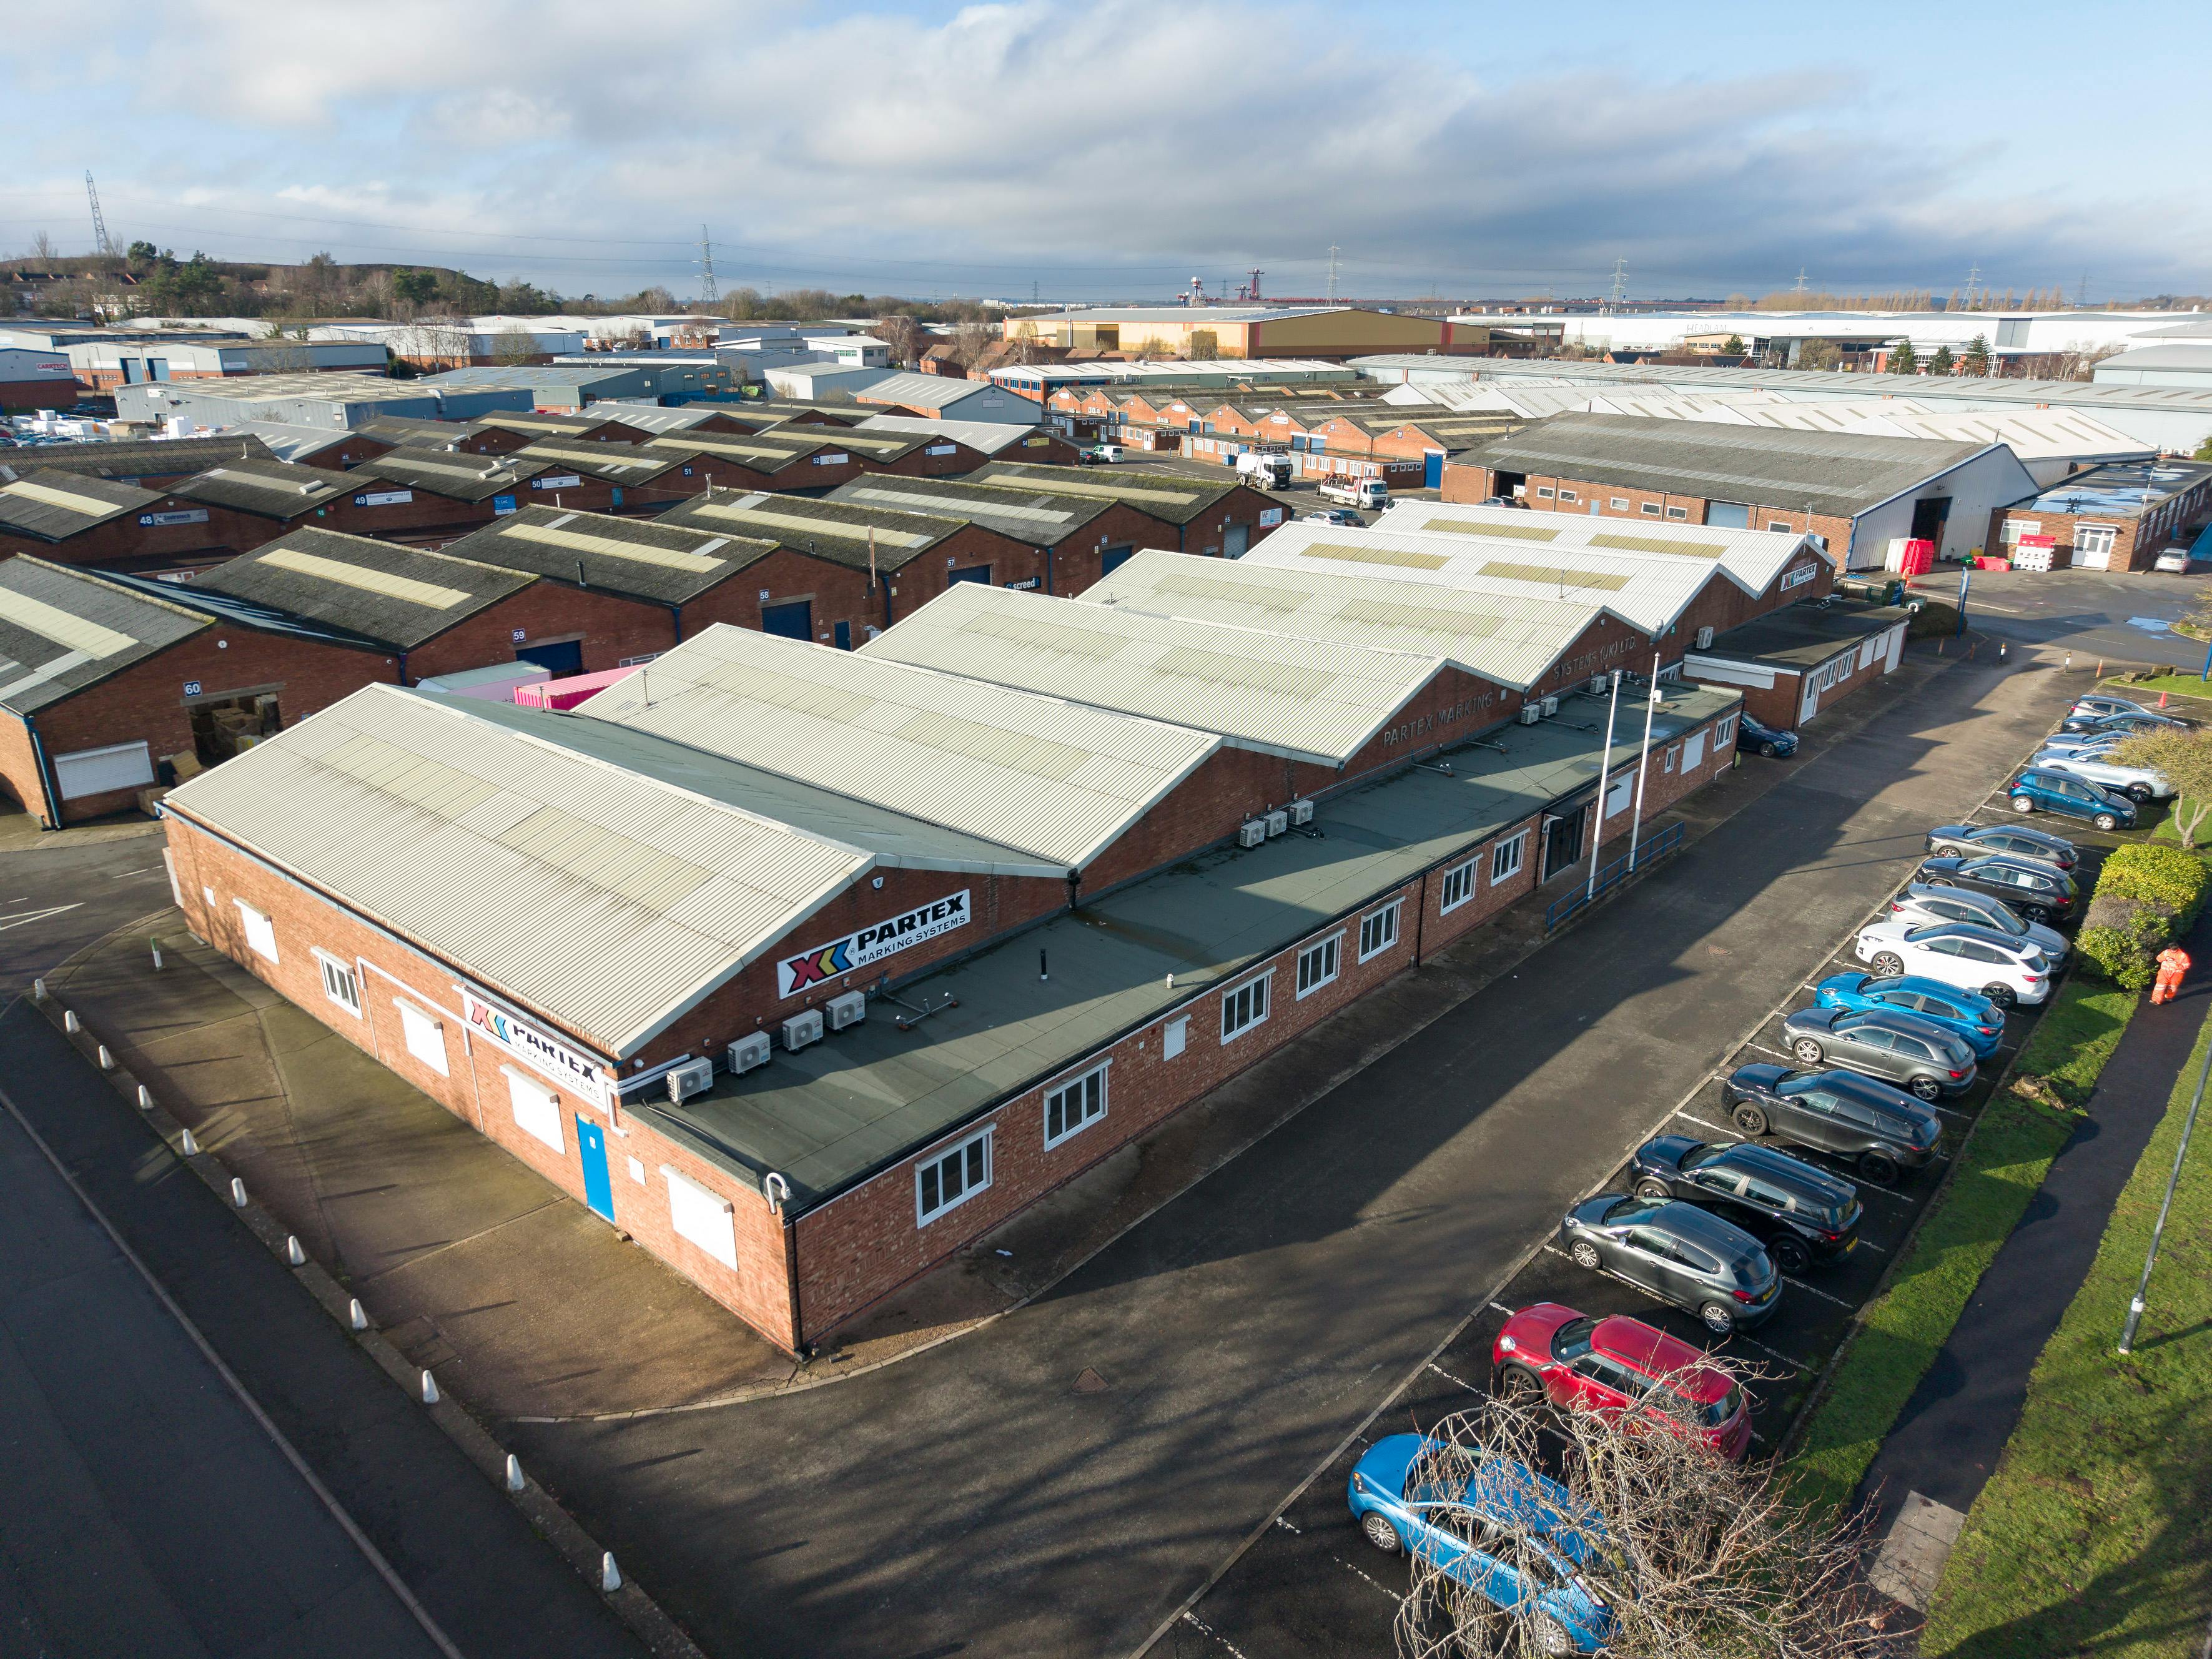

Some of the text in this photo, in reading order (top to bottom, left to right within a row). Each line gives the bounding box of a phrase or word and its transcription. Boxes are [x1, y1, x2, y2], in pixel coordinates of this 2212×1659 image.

[1687, 324, 1727, 334] HEADLAM
[140, 516, 152, 524] 48
[1795, 564, 1815, 578] PARTEX
[761, 591, 769, 599] 58
[514, 631, 524, 640] 59
[1554, 651, 1598, 680] SYSTEMS
[1600, 641, 1617, 663] (UK)
[185, 683, 199, 694] 60
[1383, 691, 1493, 748] PARTEX MARKING
[857, 894, 964, 952] PARTEX
[859, 914, 965, 965] MARKING SYSTEMS
[515, 1041, 600, 1099] MARKING SYSTEMS
